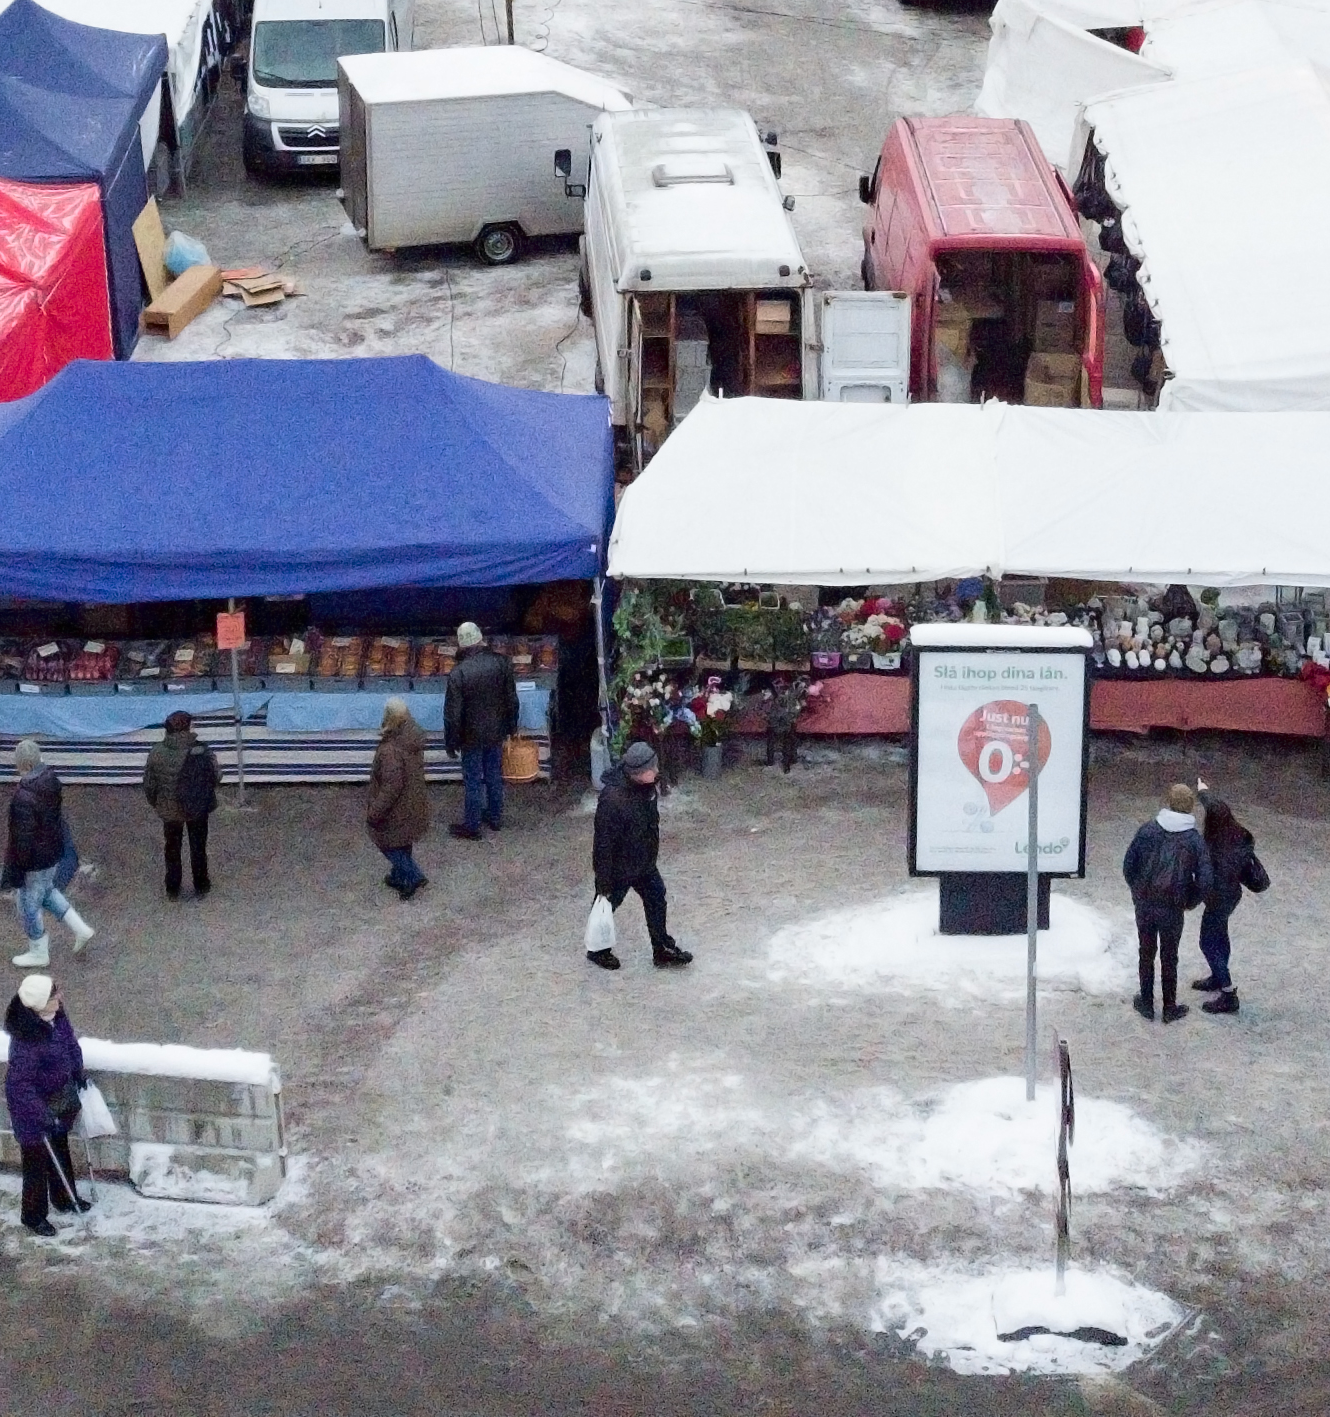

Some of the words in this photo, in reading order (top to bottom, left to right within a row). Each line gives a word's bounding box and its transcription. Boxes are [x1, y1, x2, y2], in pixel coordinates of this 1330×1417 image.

[934, 665, 958, 680] Slå
[962, 666, 997, 683] ihop
[1001, 666, 1035, 680] dina
[1040, 666, 1068, 680] lån.
[979, 709, 1009, 723] Just
[1011, 715, 1030, 726] nu
